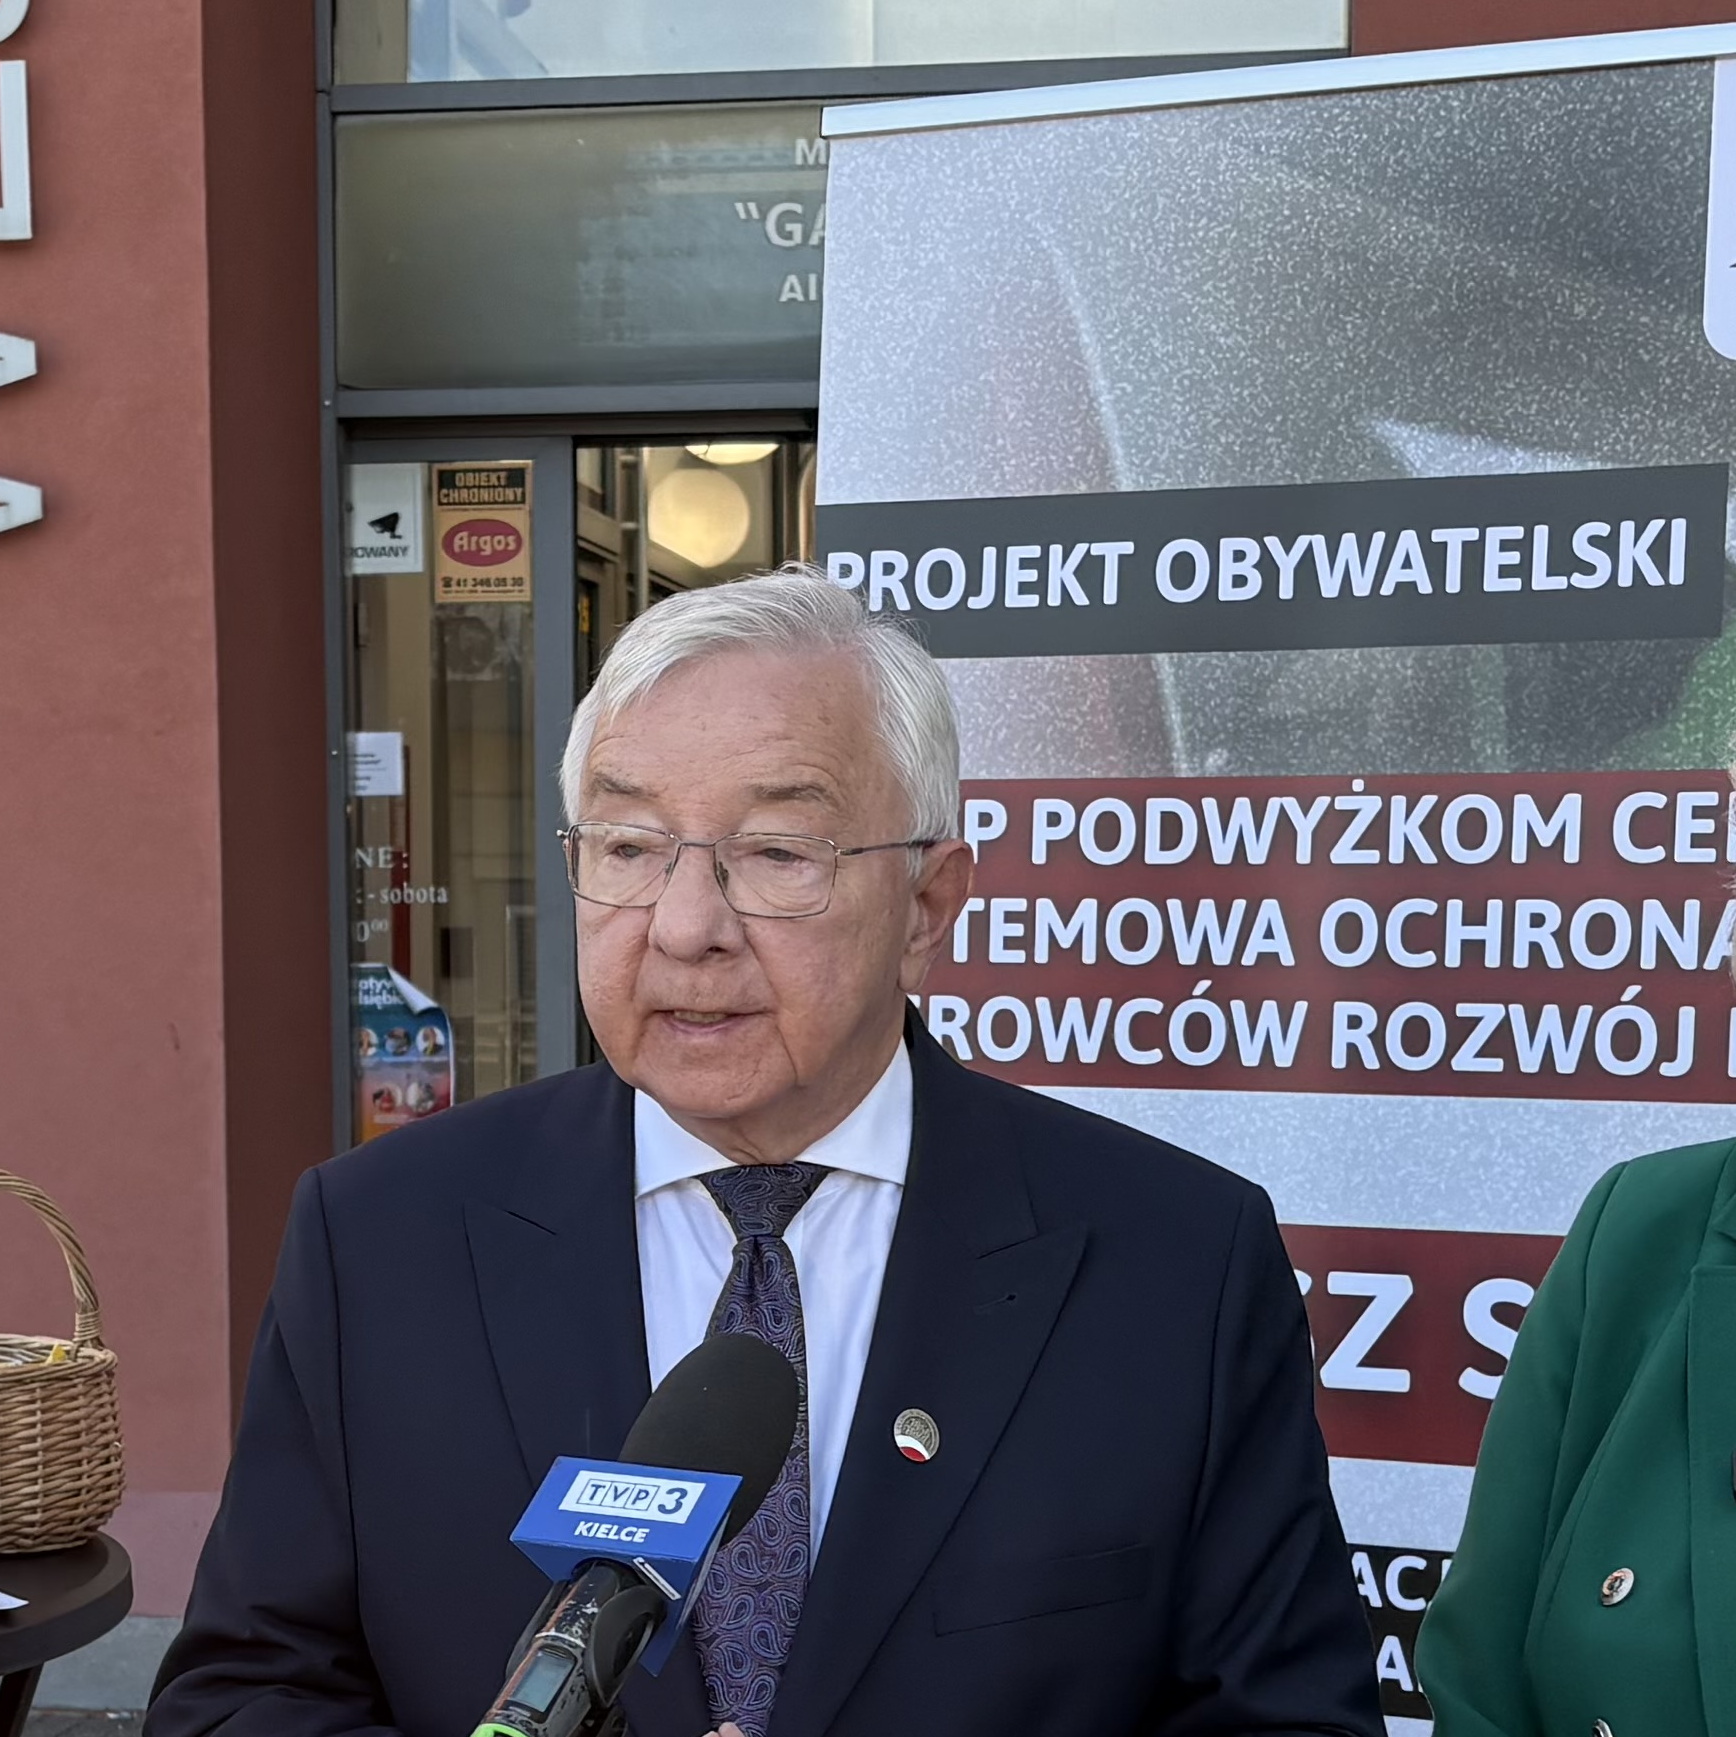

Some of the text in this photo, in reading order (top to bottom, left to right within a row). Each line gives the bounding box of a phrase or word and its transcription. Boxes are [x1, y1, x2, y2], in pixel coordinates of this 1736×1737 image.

[440, 487, 524, 503] CHRONIONY
[455, 472, 508, 487] OBIEKT
[453, 531, 518, 556] Argos
[826, 518, 1688, 613] PROJEKT OBYWATELSKI
[1031, 778, 1584, 866] PODWYŻKOM
[379, 882, 448, 905] sobota
[952, 897, 1296, 967] TEMOWA
[907, 980, 1309, 1068] ROWCÓW
[1331, 985, 1696, 1078] ROZWÓJ
[1293, 1268, 1414, 1393] Z
[589, 1483, 689, 1515] TVP 3
[574, 1520, 650, 1543] KIELCE
[1351, 1551, 1453, 1612] AC
